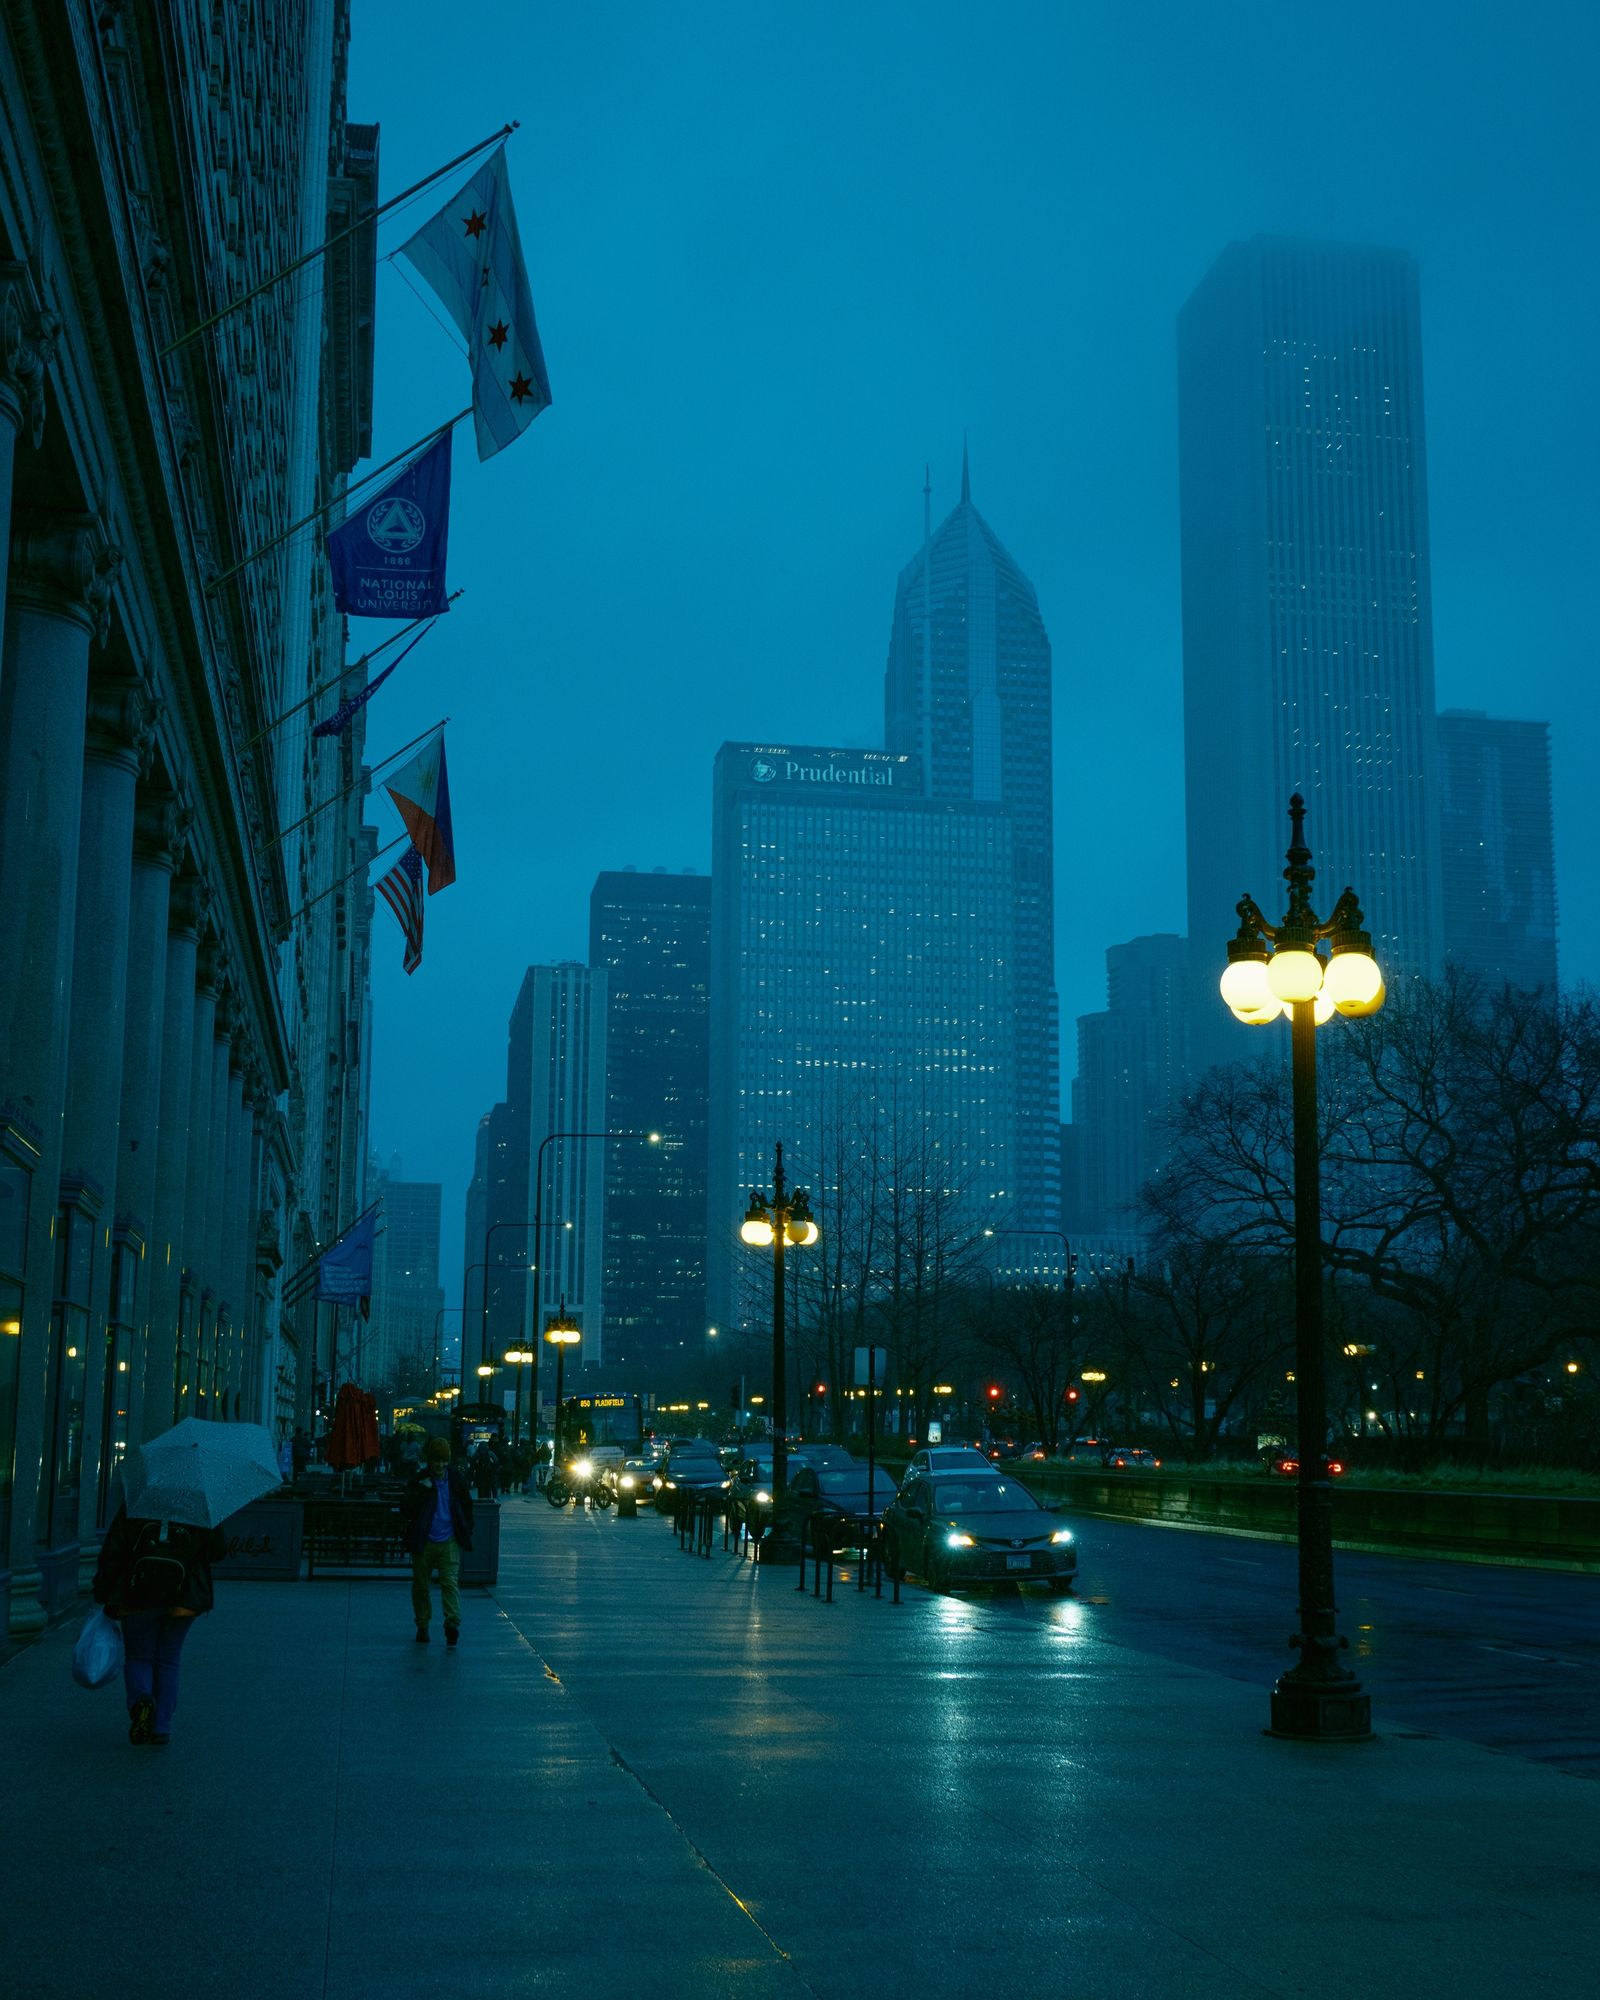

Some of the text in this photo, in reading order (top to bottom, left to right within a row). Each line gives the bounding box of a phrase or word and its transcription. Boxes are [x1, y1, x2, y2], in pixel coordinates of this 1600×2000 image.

[384, 556, 411, 565] 1886
[360, 577, 435, 590] NATIONAL
[377, 590, 418, 600] LOUIS
[784, 761, 893, 785] Prudential
[594, 1399, 624, 1407] PLAINFIELD
